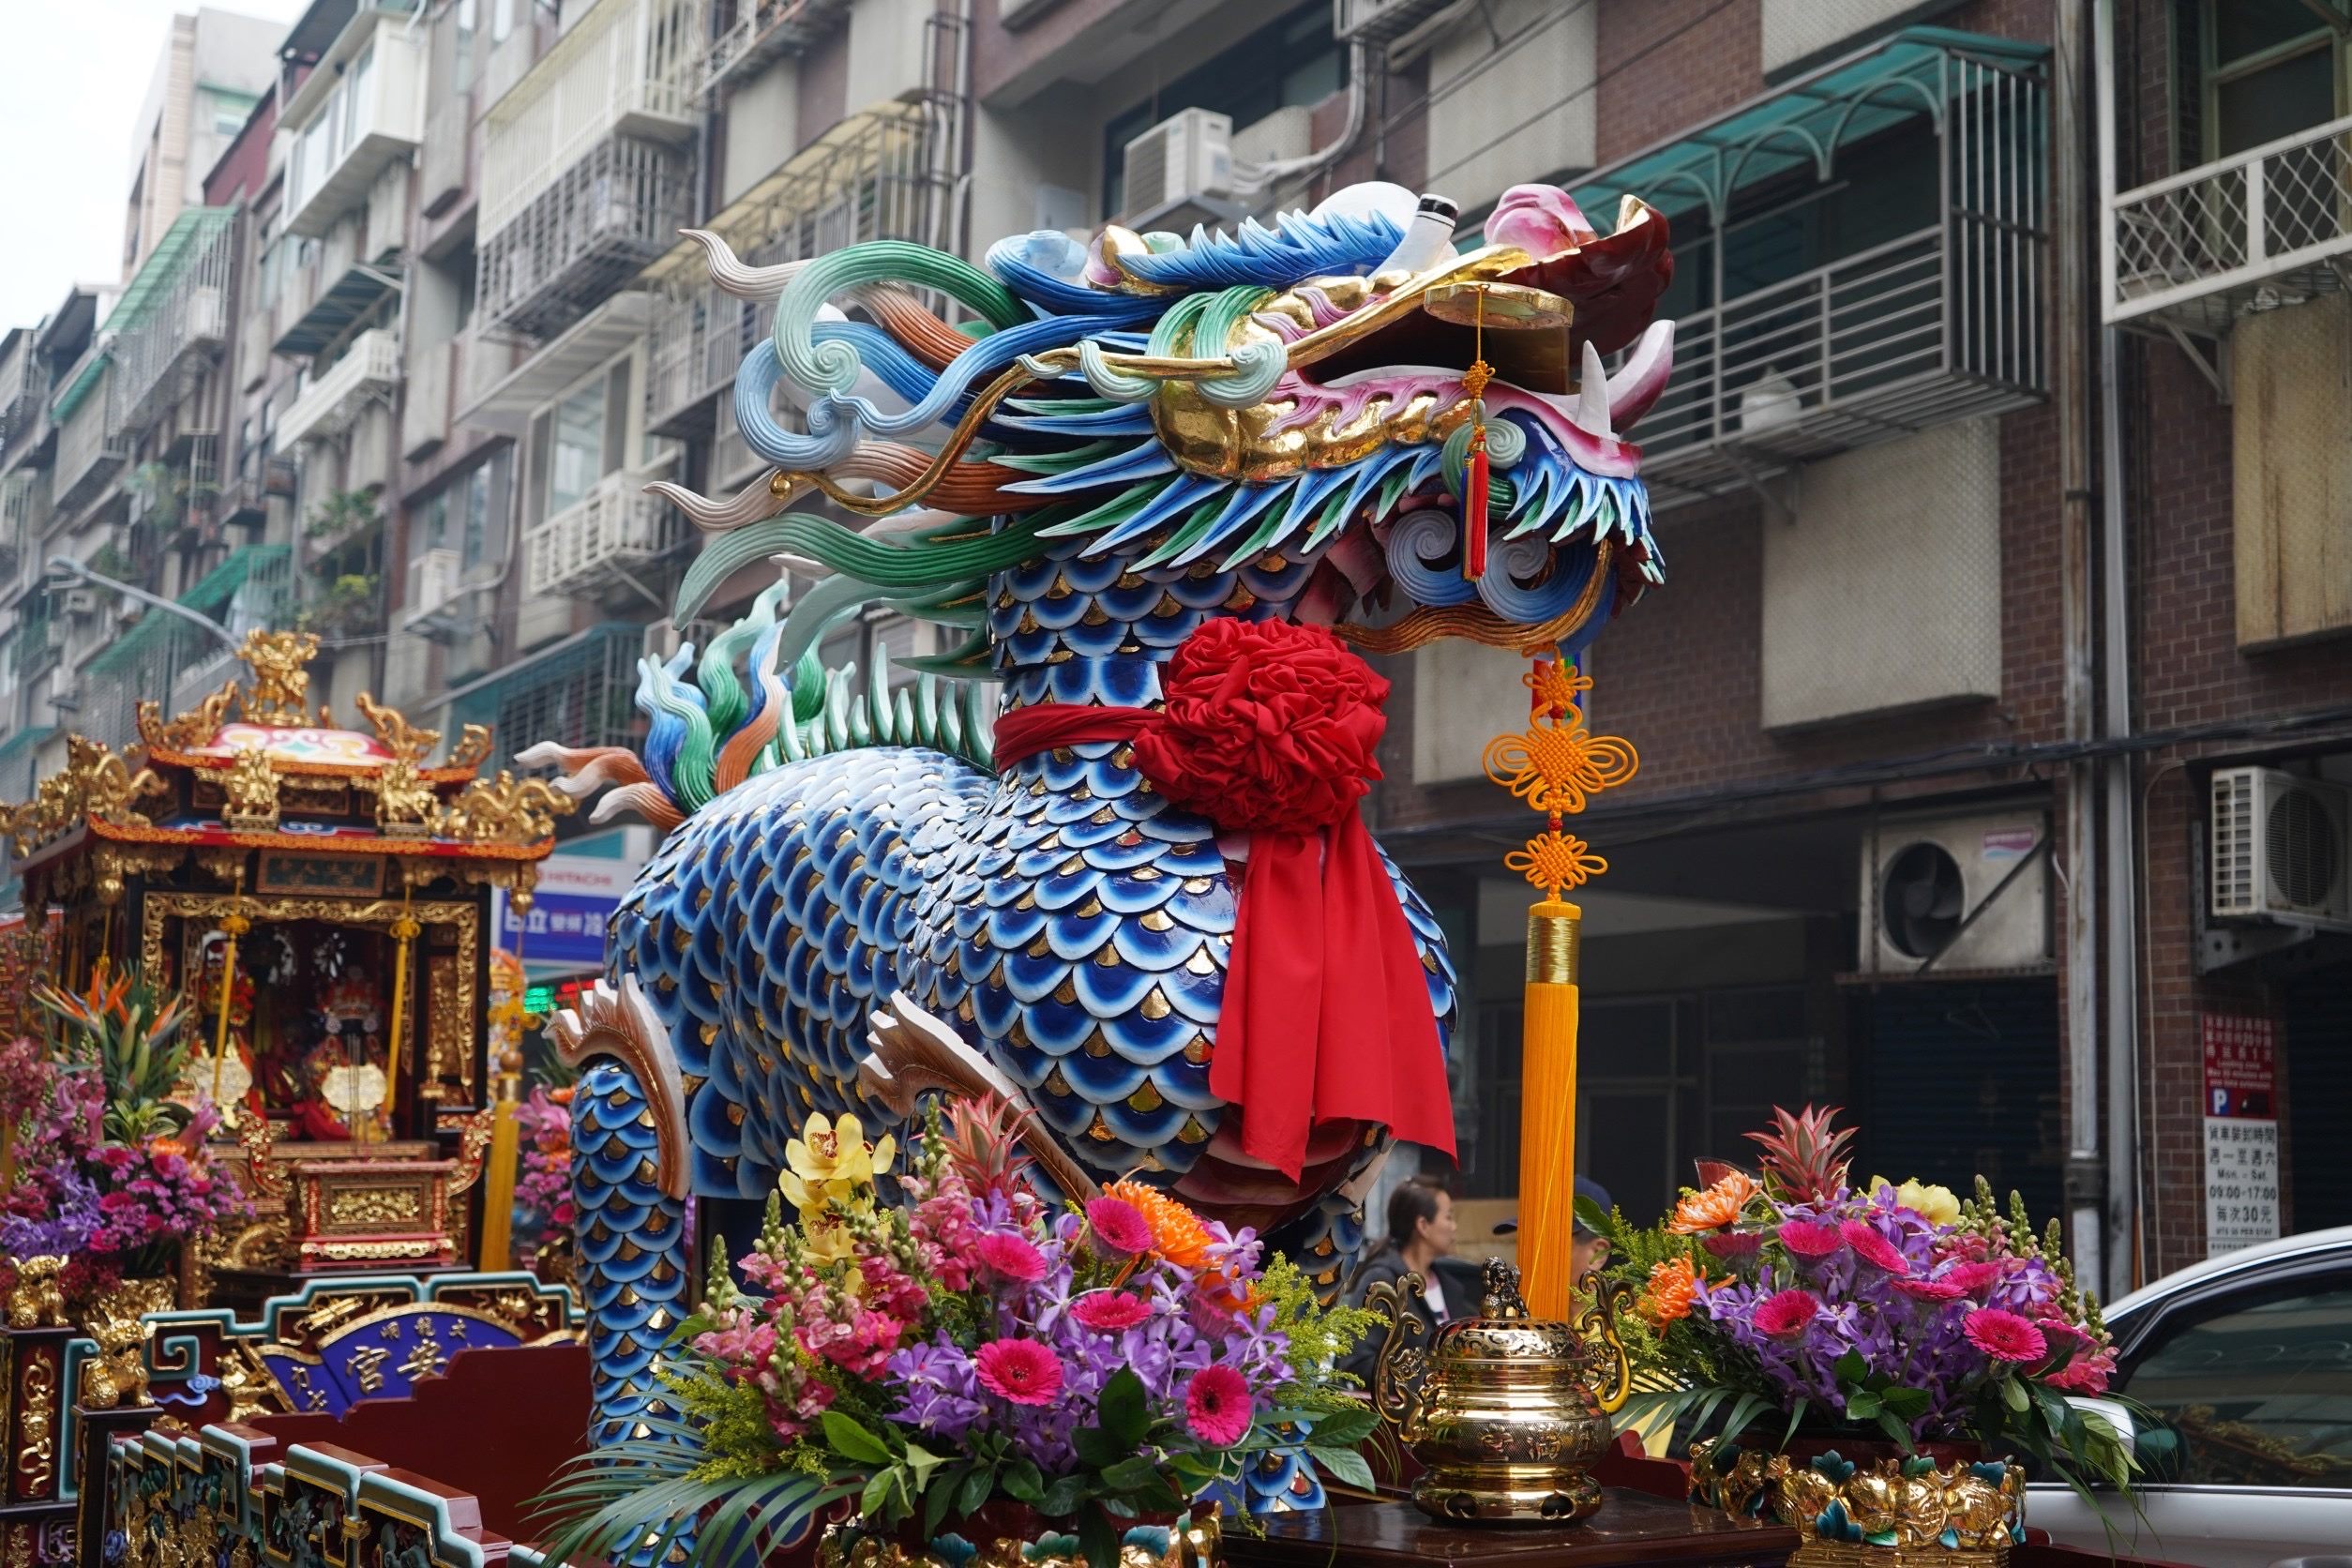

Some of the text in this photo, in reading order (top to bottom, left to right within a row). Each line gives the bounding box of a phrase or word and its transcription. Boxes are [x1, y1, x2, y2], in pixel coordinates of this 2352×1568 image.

[550, 871, 612, 885] HITACHI
[2213, 1089, 2226, 1115] P
[2209, 1124, 2275, 1144] 貨車裝卸時間
[2209, 1146, 2277, 1166] 週一至週六
[2216, 1204, 2272, 1224] 每次30元
[346, 1338, 495, 1395] 安宮
